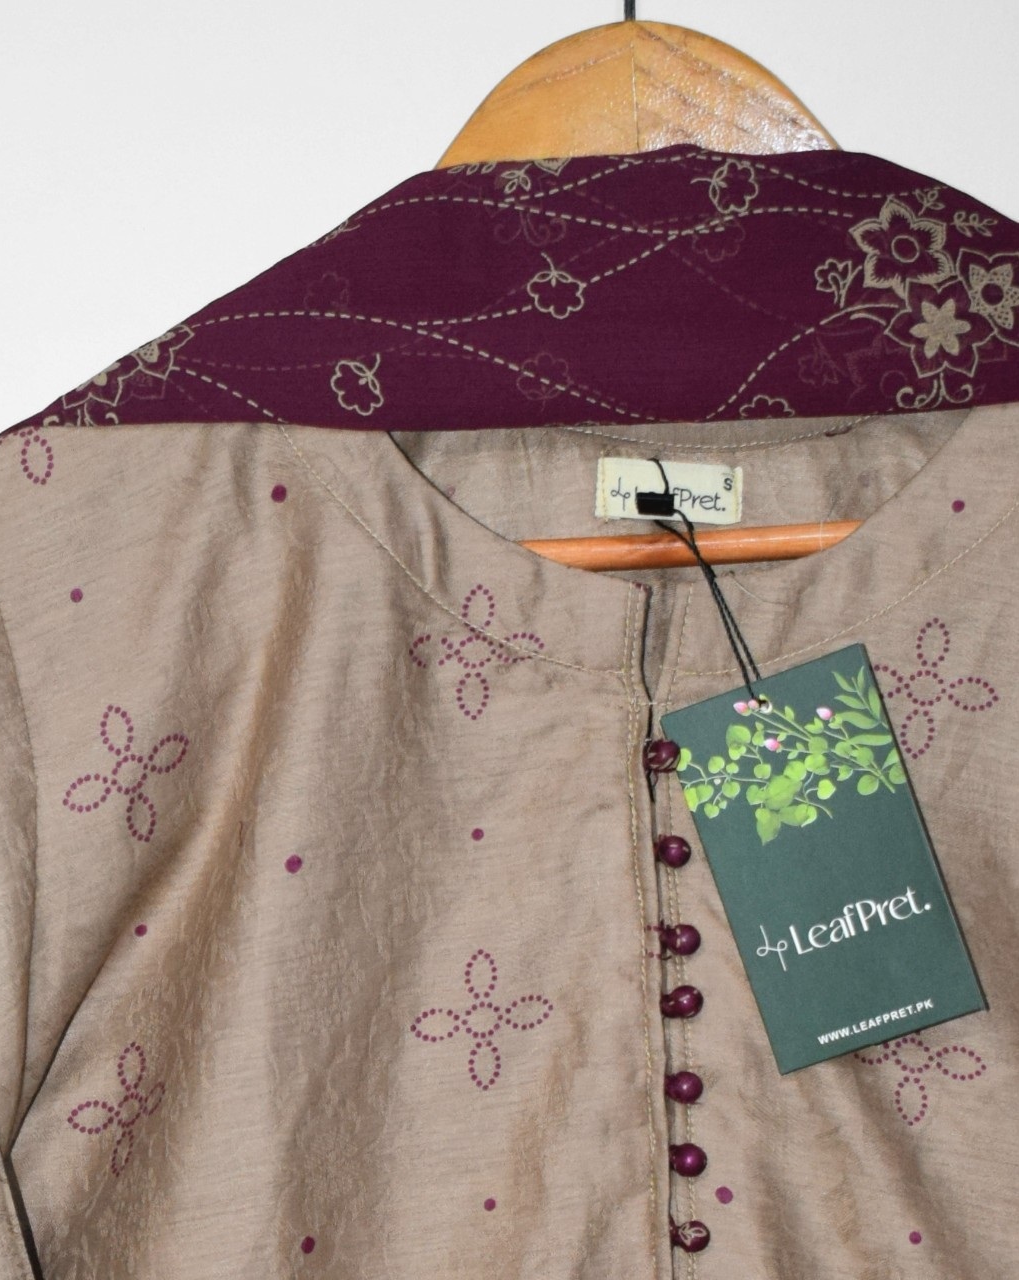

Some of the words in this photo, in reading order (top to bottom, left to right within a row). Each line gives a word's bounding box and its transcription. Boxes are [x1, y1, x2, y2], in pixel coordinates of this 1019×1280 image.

[723, 477, 733, 491] S
[789, 886, 932, 955] LeafPret.
[817, 998, 934, 1045] WWW.LEAFPRET.PK
